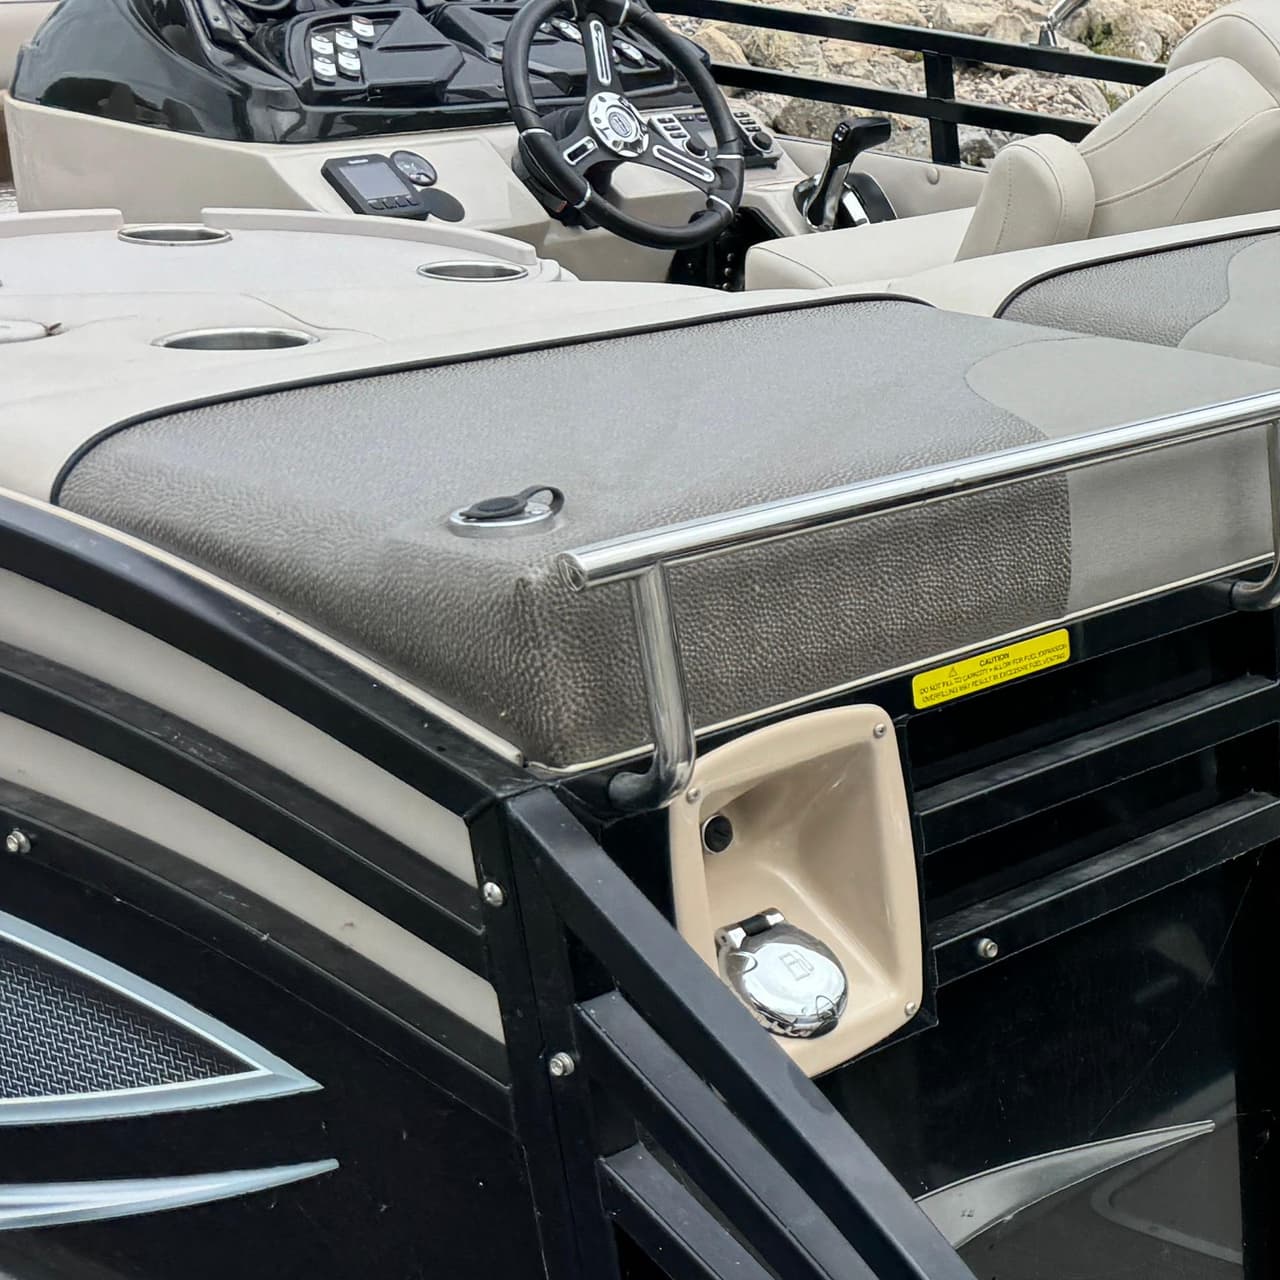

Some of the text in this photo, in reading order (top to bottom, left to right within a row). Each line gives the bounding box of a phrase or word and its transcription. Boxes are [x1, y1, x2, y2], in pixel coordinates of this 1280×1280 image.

[919, 687, 929, 695] DO
[930, 683, 941, 692] NOT
[942, 680, 953, 688] FILL
[1012, 657, 1023, 665] FOR
[1024, 653, 1037, 662] FUEL
[979, 653, 1010, 667] CAUTION
